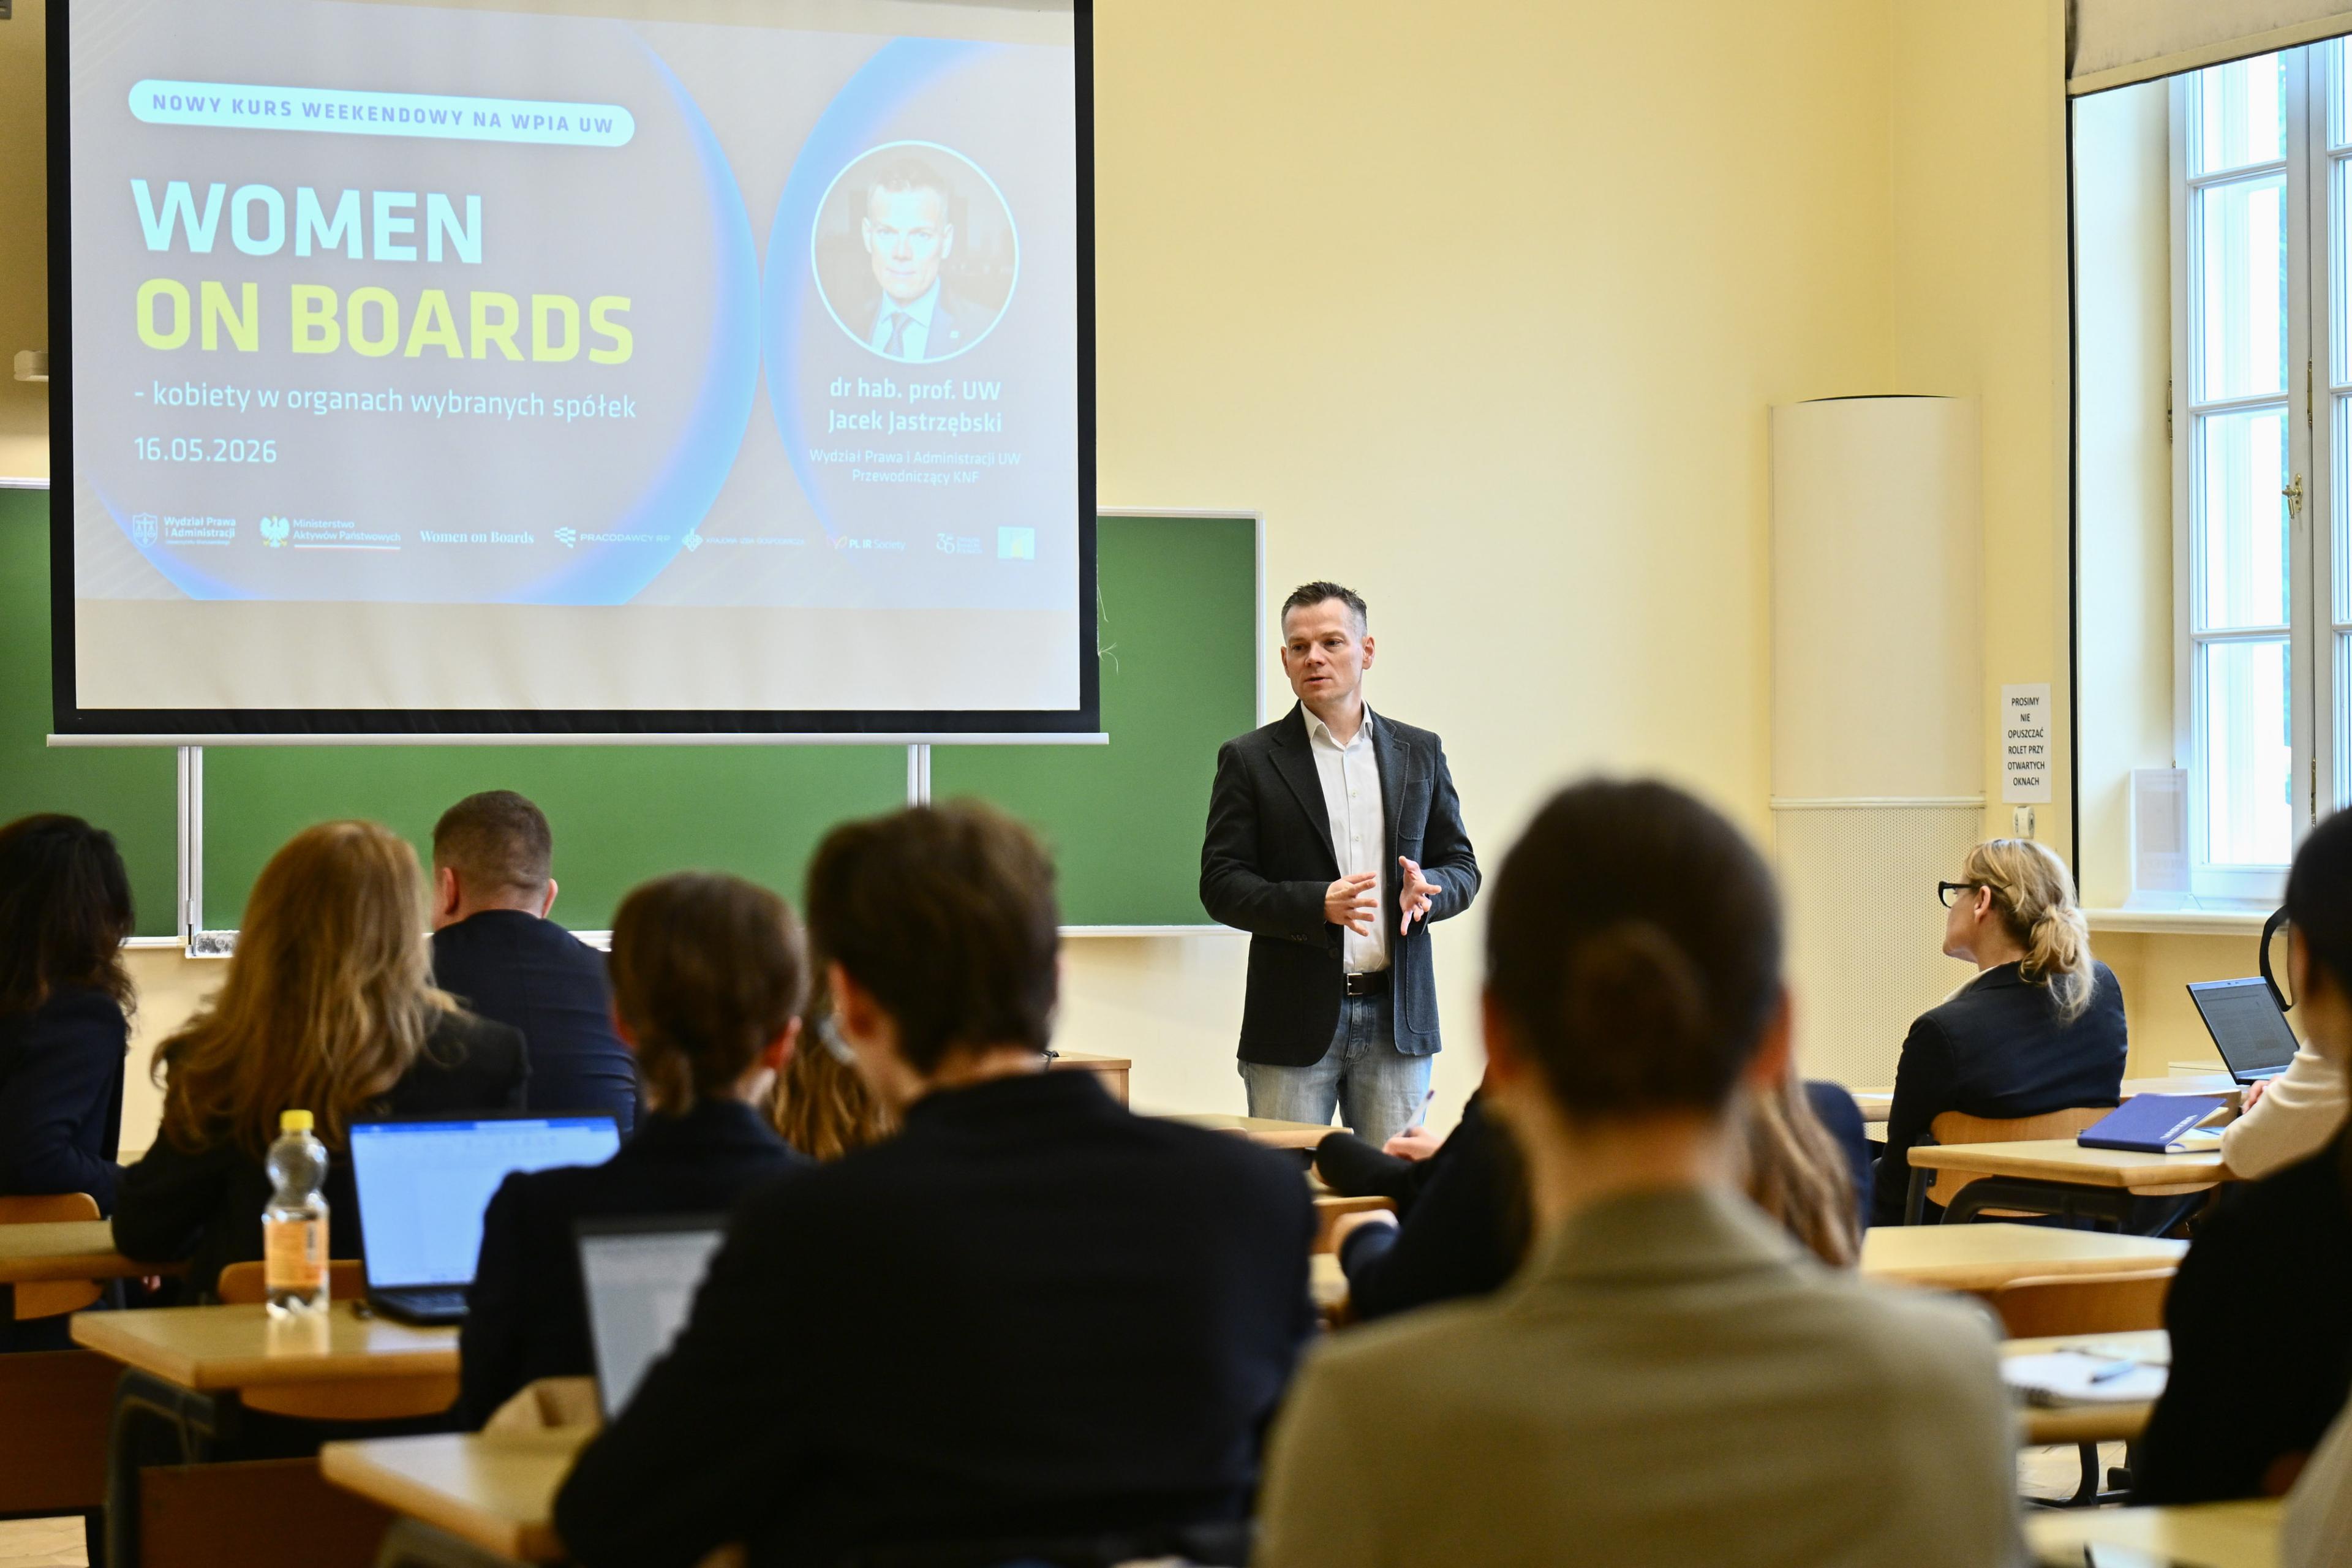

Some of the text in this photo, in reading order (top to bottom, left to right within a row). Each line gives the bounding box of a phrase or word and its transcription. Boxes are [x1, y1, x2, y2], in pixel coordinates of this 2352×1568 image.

[153, 94, 613, 134] NOWY KURS WEEKENDOWY NA WPIA UW
[130, 179, 482, 265] WOMEN
[137, 278, 633, 364] ON BOARDS
[830, 377, 1001, 404] dr hab. prof. UW
[154, 380, 251, 413] kobiety
[257, 390, 280, 408] w
[288, 388, 402, 415] organach
[411, 389, 544, 421] wybranych
[553, 394, 636, 423] spółek
[828, 409, 1001, 437] Jacek Jastrzębski
[134, 437, 277, 463] 16.05.2026
[809, 449, 861, 464] Wydział
[865, 450, 903, 464] Prawa
[913, 451, 995, 467] Administracji
[998, 453, 1022, 465] UW
[852, 469, 979, 486] Przewodniczący KNF
[164, 516, 236, 527] Wydział Prawa
[293, 519, 355, 529] Ministerstwo
[170, 527, 235, 540] Administracji
[293, 530, 401, 543] Aktywów Państwowych
[420, 530, 535, 544] Women on Boards
[579, 533, 671, 543] PRACODAWCY RP
[849, 538, 861, 549] PL
[2011, 697, 2040, 706] PROSIMY
[2020, 713, 2030, 722] NIE
[2008, 727, 2044, 739] OPUSZCZAĆ
[2008, 745, 2044, 755] ROLET PRZY
[2007, 761, 2045, 771] OTWARTYCH
[2013, 777, 2040, 786] OKNACH
